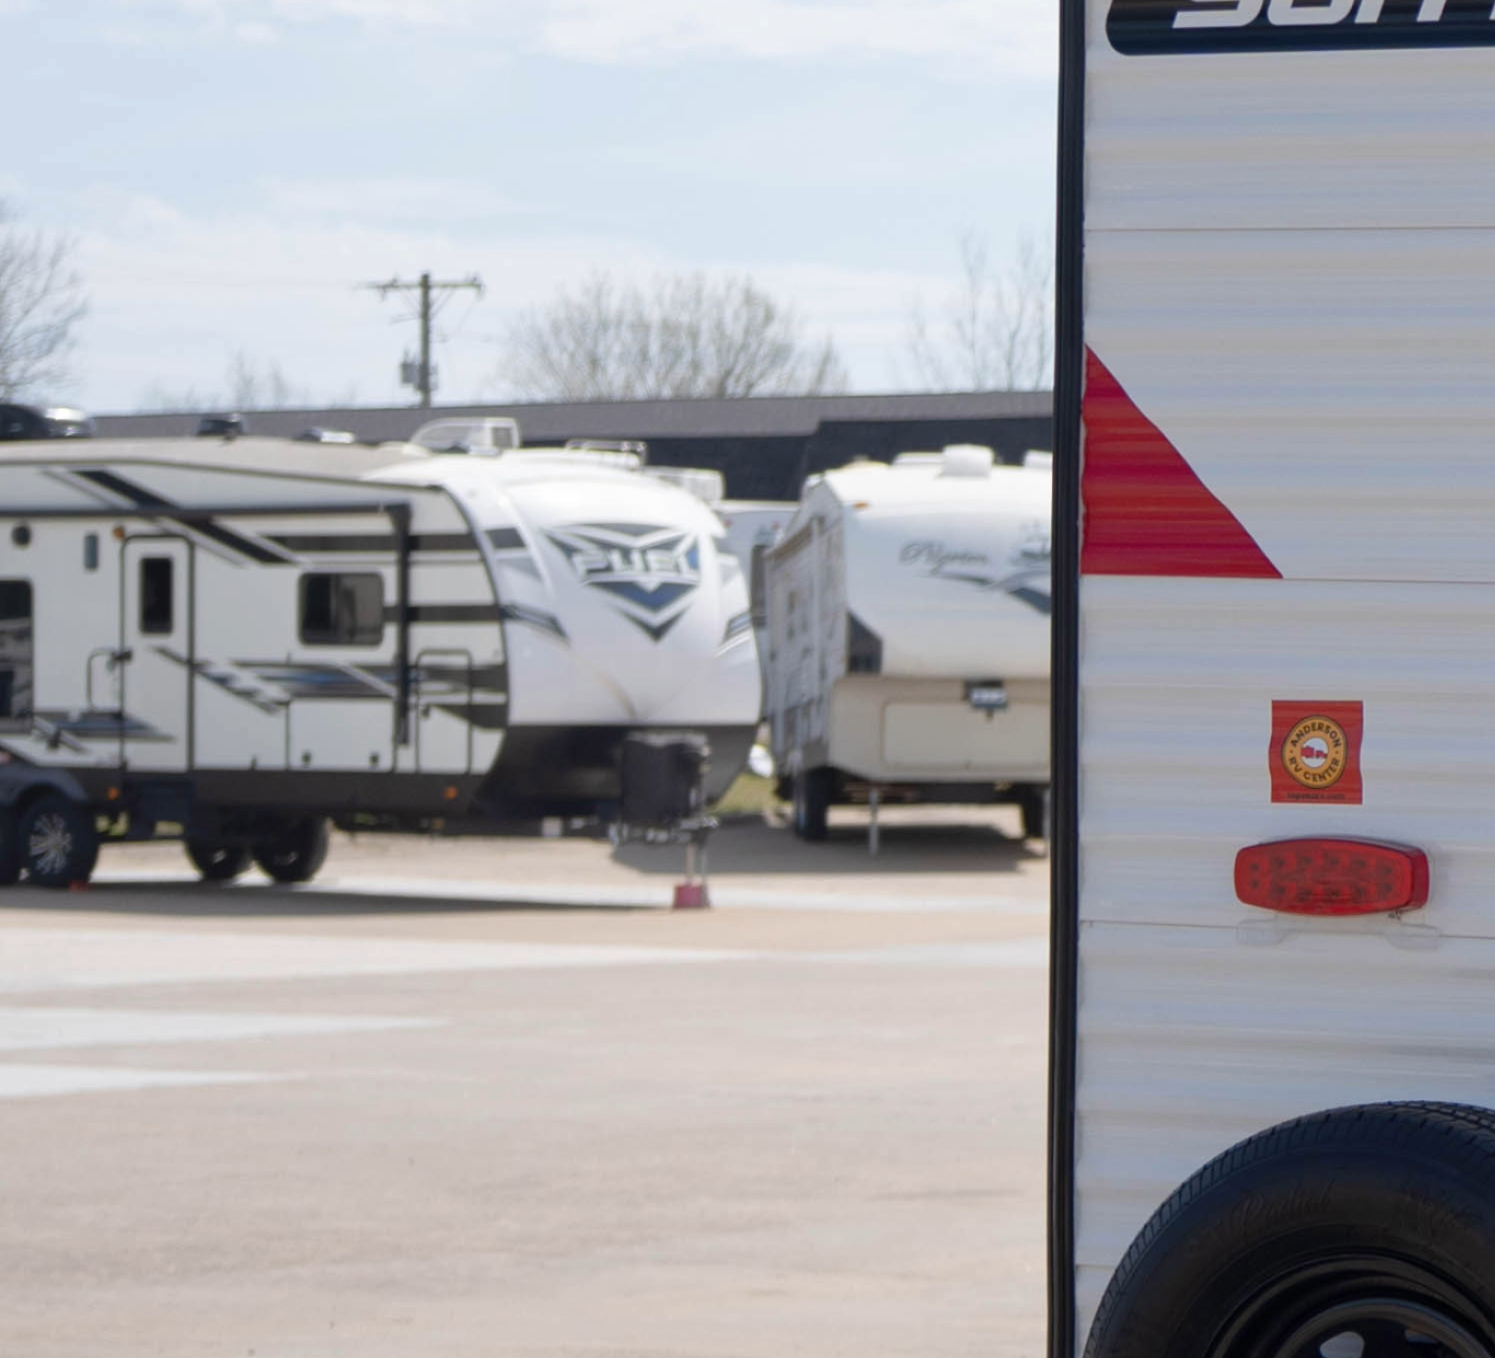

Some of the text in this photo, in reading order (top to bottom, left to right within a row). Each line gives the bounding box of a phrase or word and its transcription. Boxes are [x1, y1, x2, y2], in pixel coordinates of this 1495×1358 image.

[1291, 722, 1342, 748] ANDERSON
[1289, 756, 1341, 782] RV CENTER
